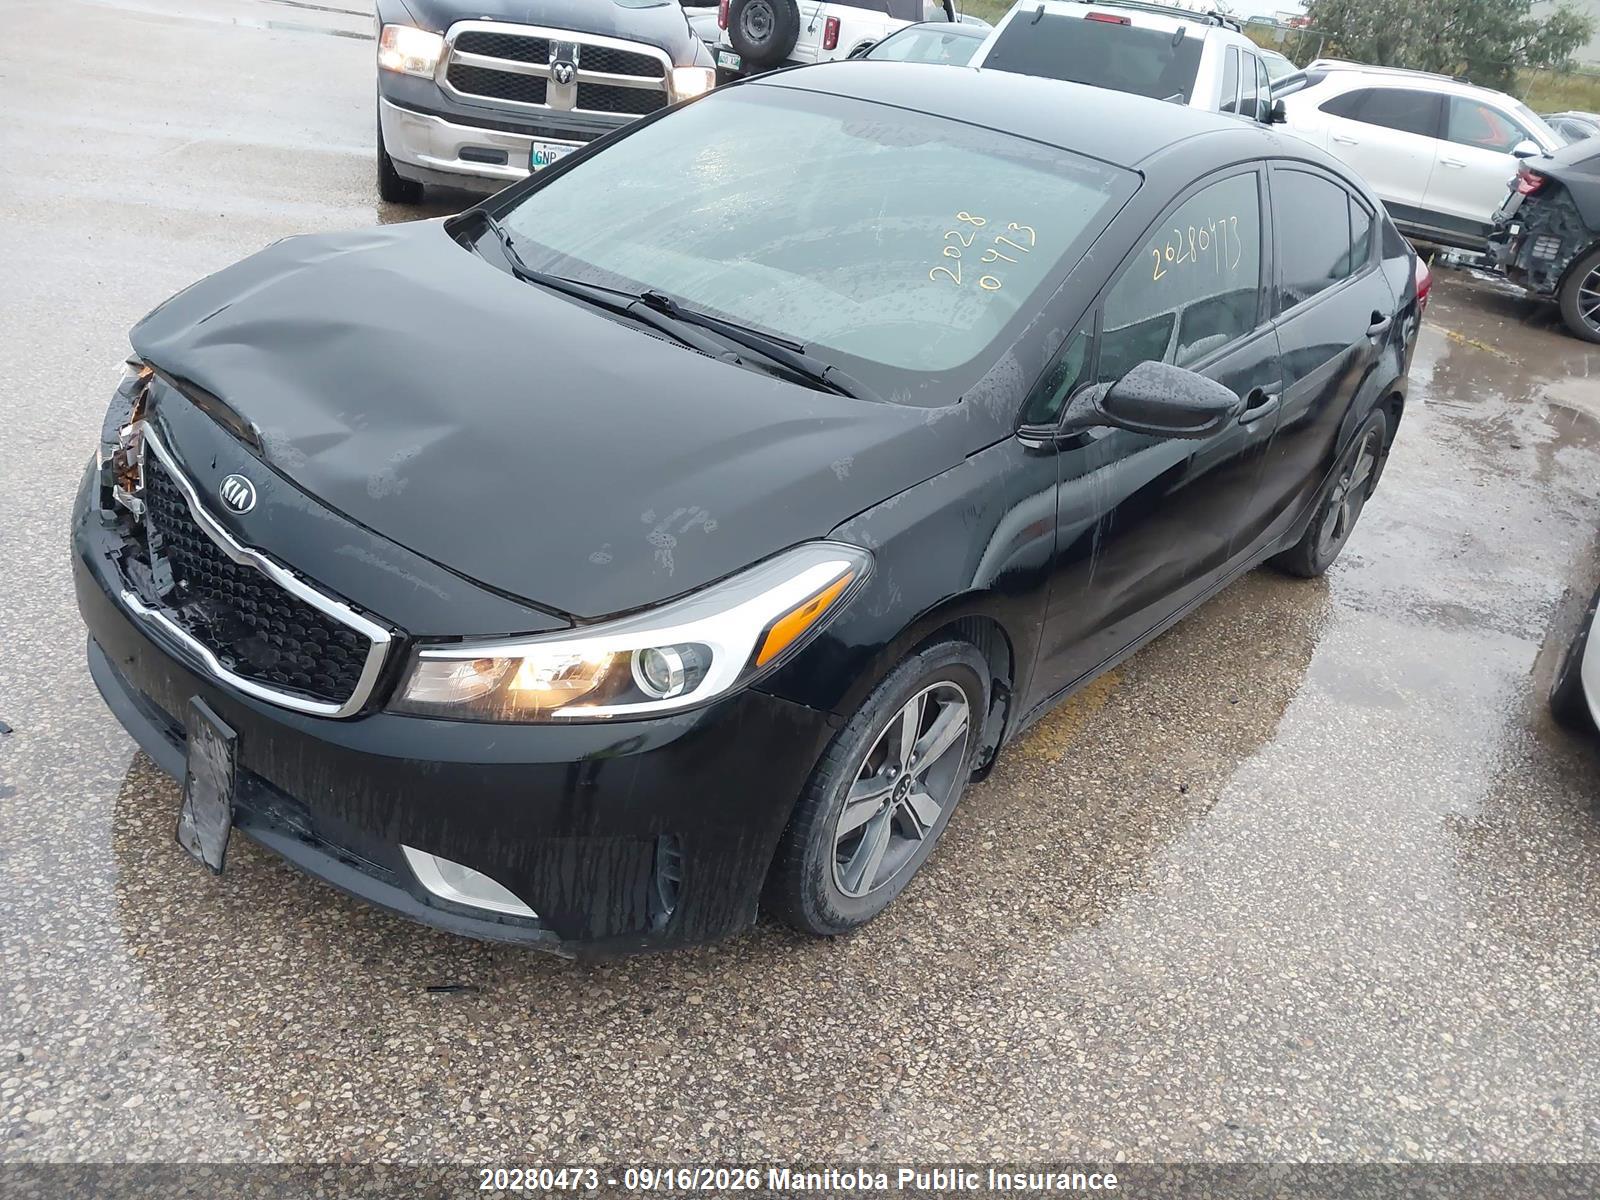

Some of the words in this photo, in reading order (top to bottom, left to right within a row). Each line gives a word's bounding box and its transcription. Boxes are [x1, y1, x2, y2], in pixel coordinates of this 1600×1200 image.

[535, 150, 557, 166] GNP
[929, 211, 986, 285] 2028
[980, 222, 1036, 290] 0473
[1152, 216, 1242, 281] 20280473
[221, 477, 249, 510] KIA
